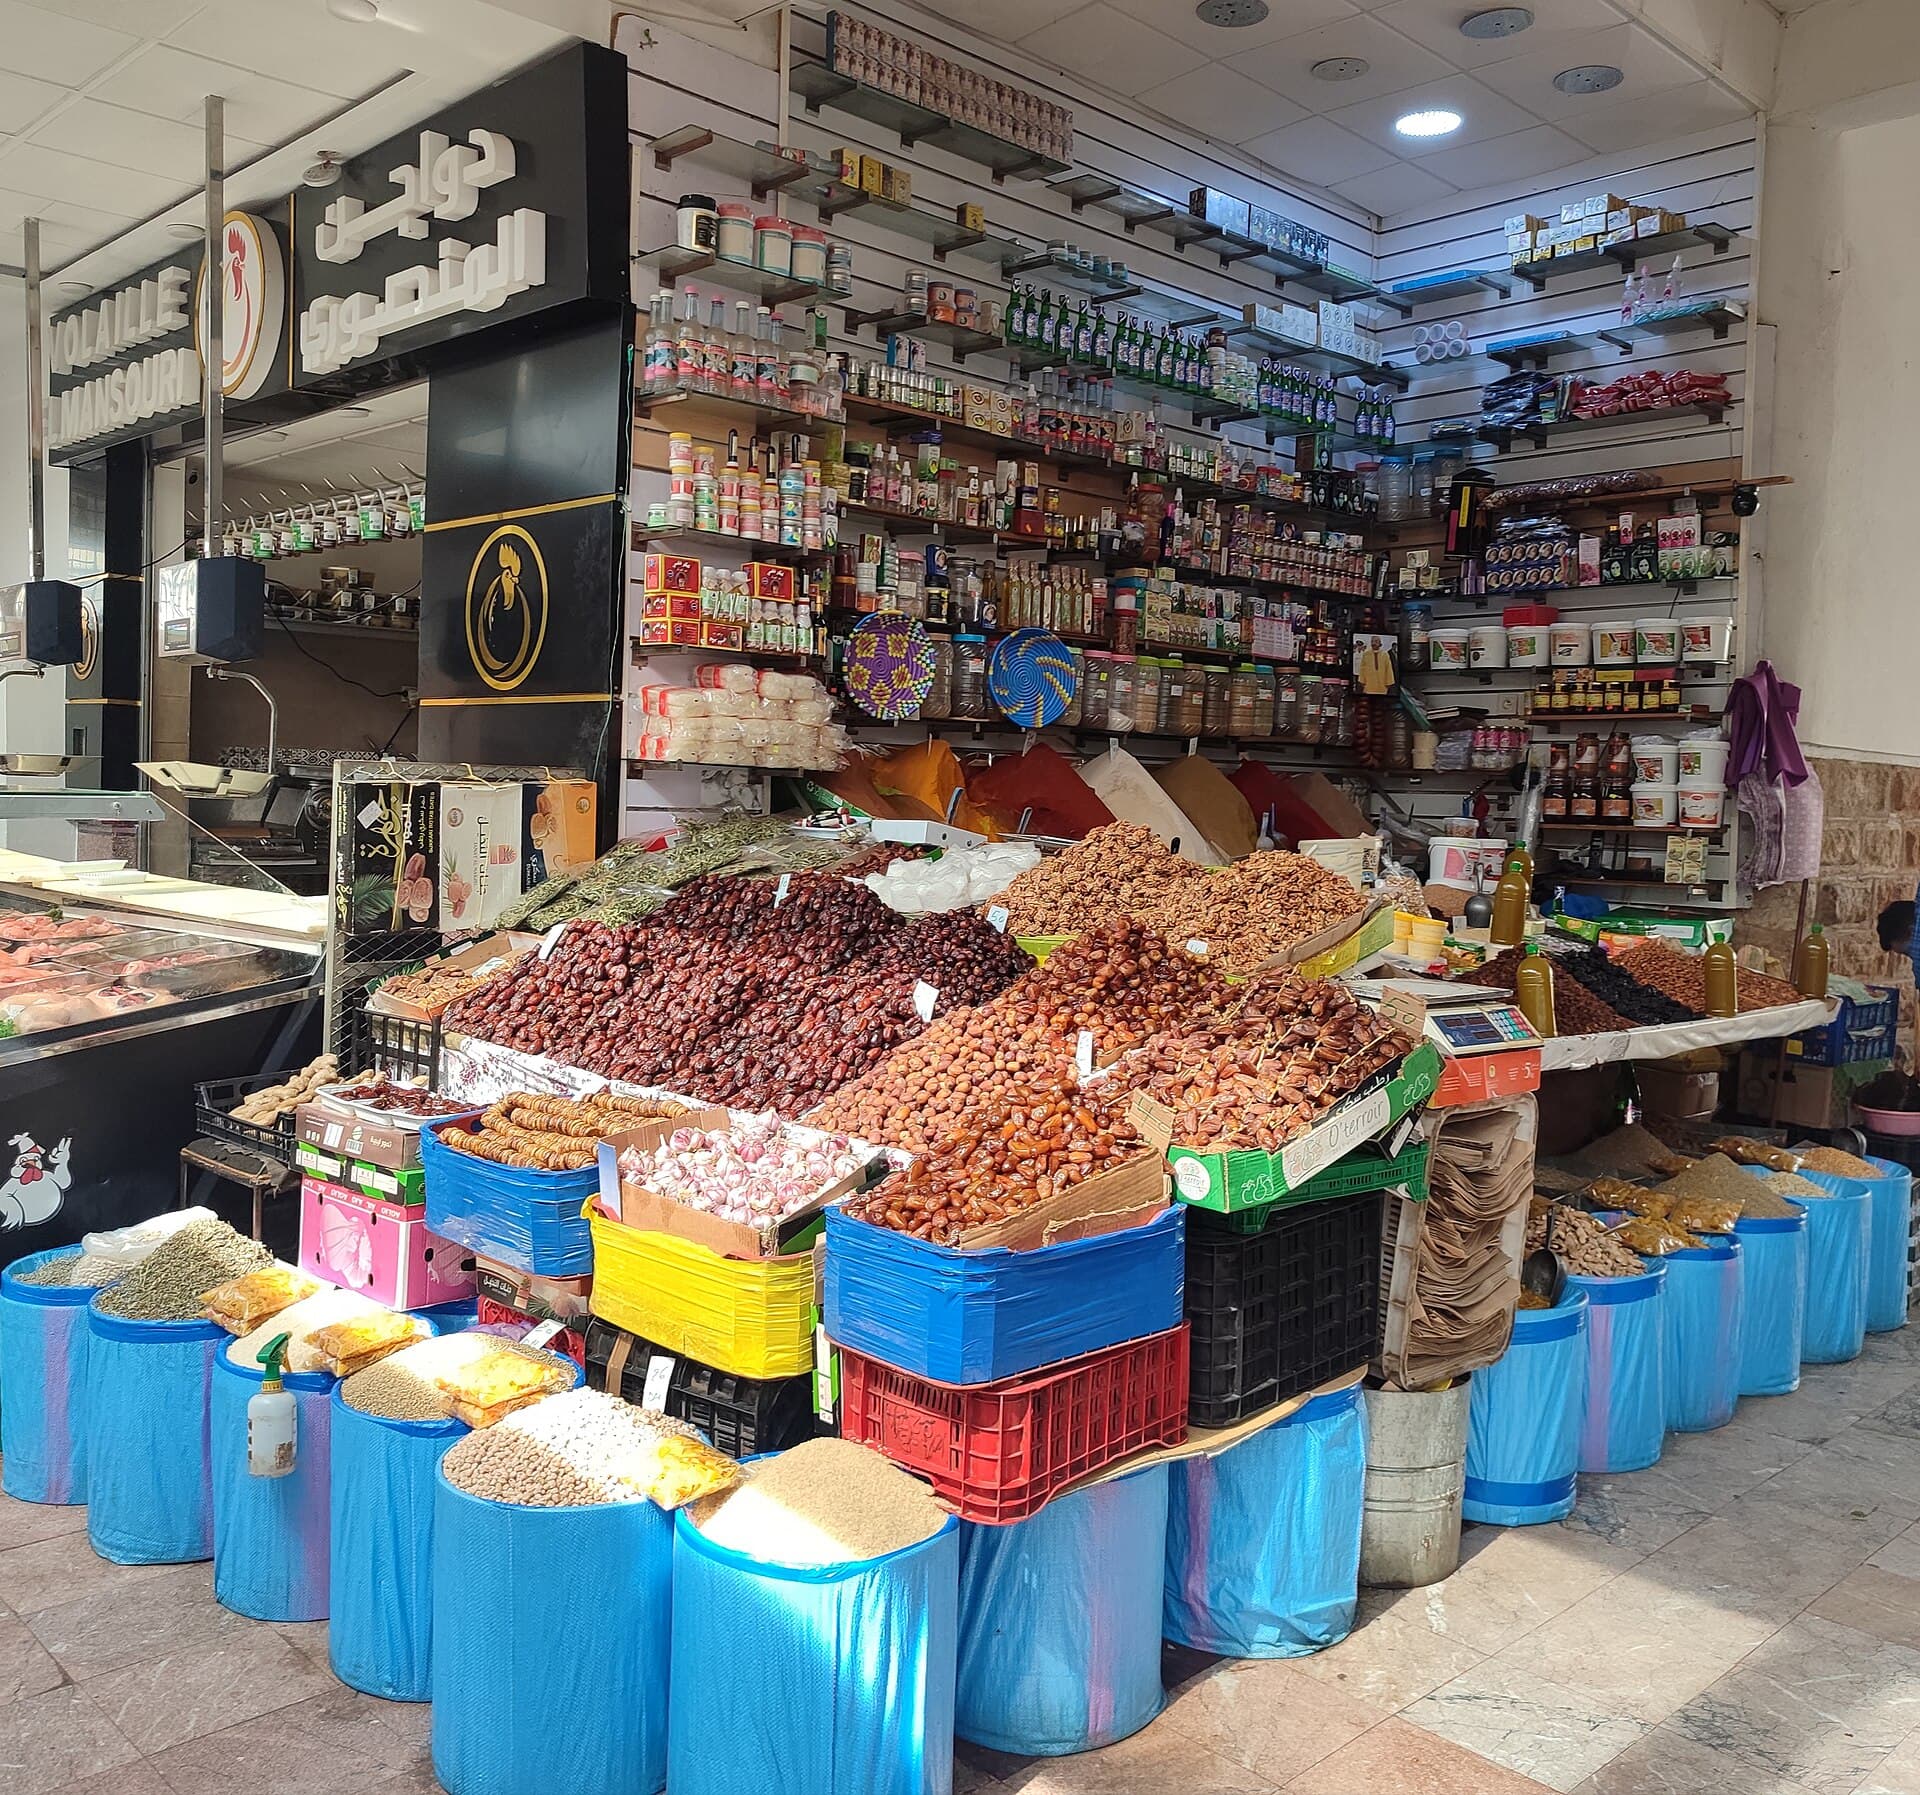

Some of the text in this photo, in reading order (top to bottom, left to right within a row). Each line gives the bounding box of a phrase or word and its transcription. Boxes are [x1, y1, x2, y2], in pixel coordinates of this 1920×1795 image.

[315, 128, 516, 264] دواجن
[300, 207, 546, 375] المنصوري
[49, 265, 191, 375] VOLAILLE
[61, 347, 201, 445] MANSOURI
[476, 816, 489, 859] النخيل
[330, 1190, 348, 1200] AGLIO
[351, 1196, 363, 1206] AJO
[366, 1201, 376, 1211] AIL
[381, 1207, 401, 1217] AGLIO
